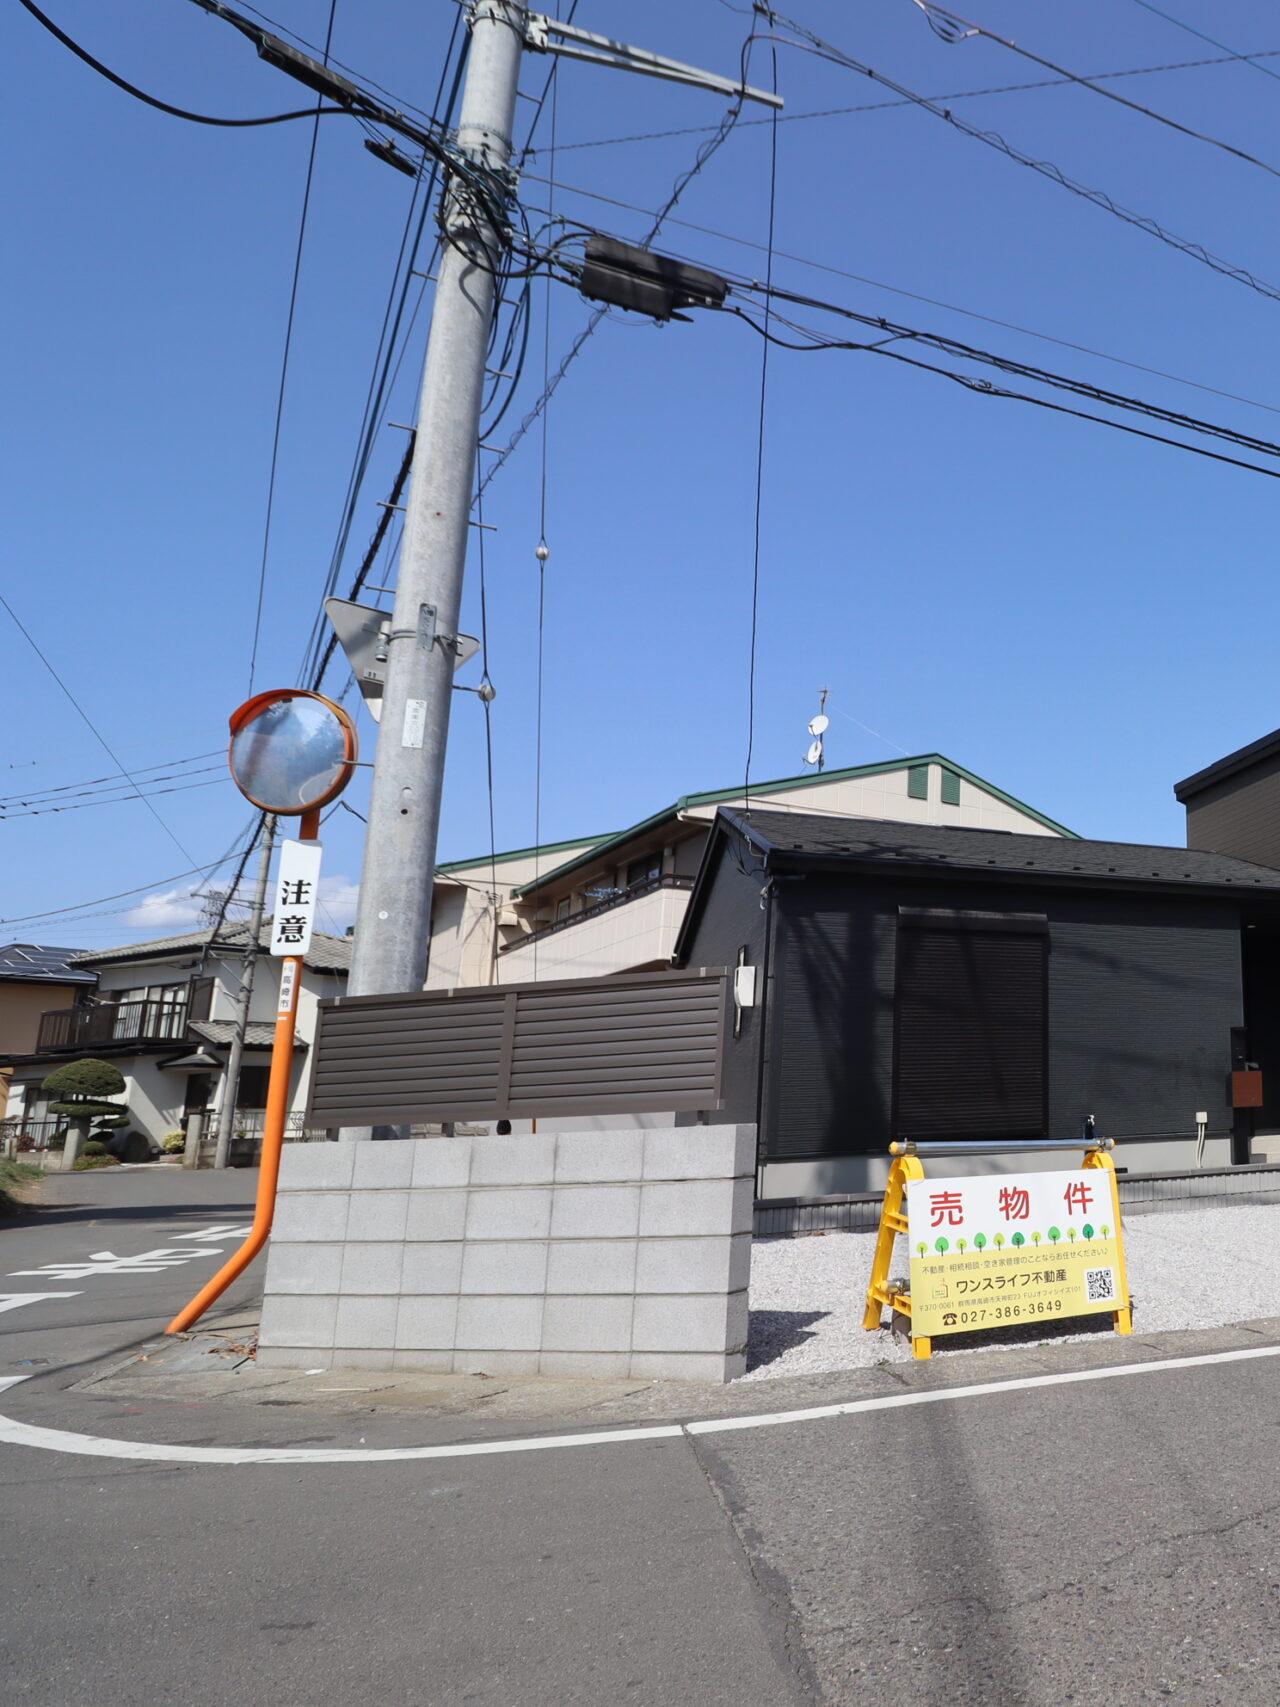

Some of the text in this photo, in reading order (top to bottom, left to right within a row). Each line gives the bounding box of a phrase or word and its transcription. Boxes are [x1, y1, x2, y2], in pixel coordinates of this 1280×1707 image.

[277, 879, 312, 943] 注意
[929, 1181, 1094, 1227] 売物件
[956, 1269, 1067, 1294] ワンスライフ不動産
[961, 1300, 1062, 1323] 027-386-3649
